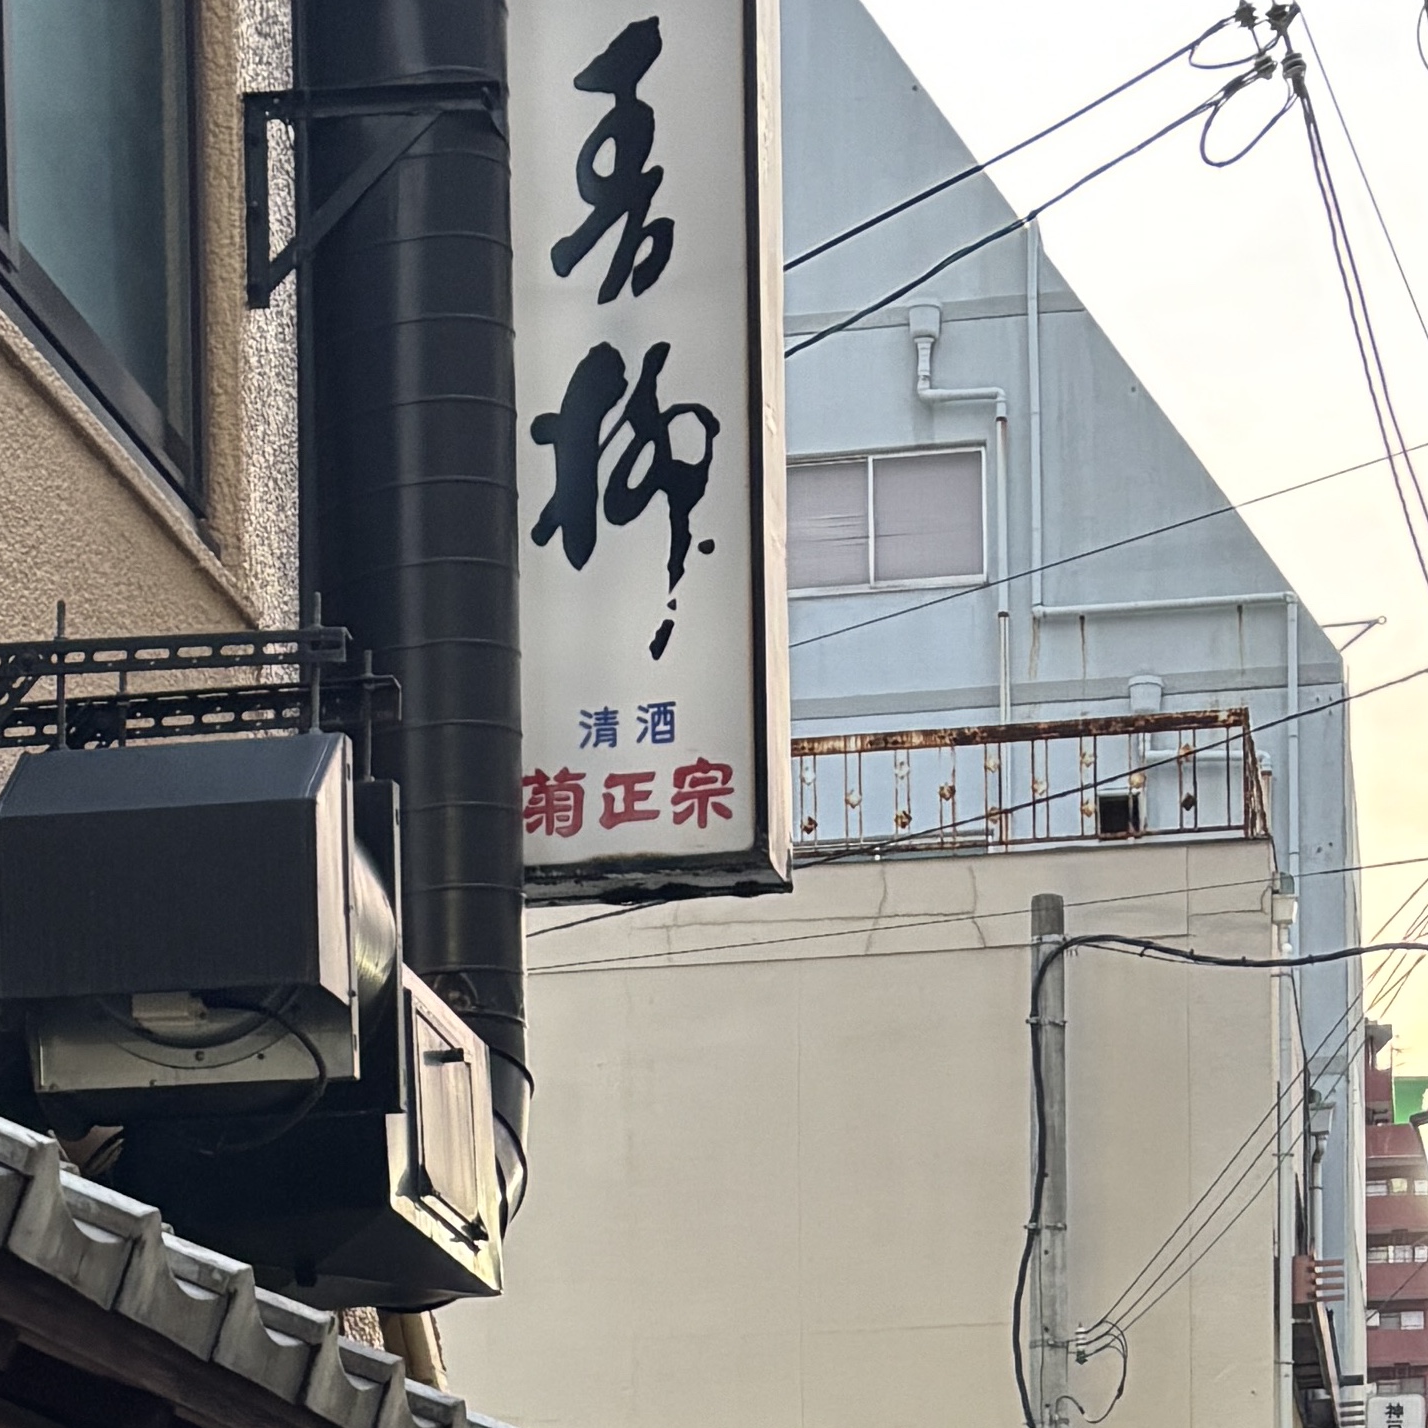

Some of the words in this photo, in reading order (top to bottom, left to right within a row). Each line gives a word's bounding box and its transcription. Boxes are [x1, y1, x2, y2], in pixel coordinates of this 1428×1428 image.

[578, 701, 676, 749] 清酒
[523, 757, 734, 839] 菊正宗
